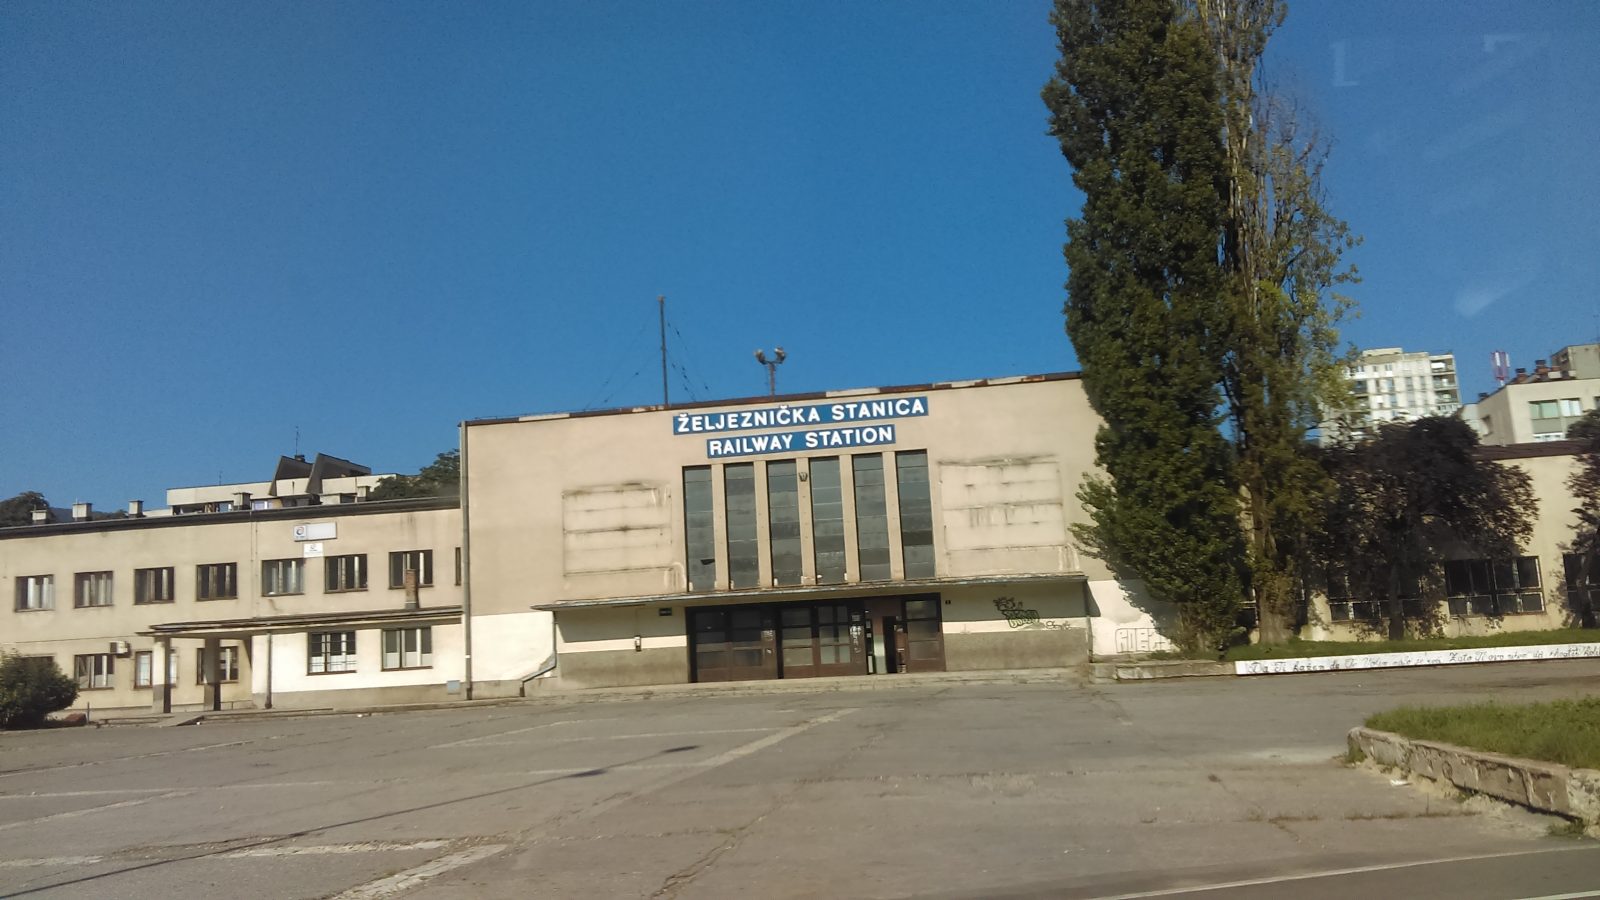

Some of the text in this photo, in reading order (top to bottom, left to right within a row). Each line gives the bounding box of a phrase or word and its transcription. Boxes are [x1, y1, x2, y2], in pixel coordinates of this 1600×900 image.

[677, 398, 925, 432] ŽELJEZNIČKA STANICA
[709, 425, 892, 456] RAILWAY STATION
